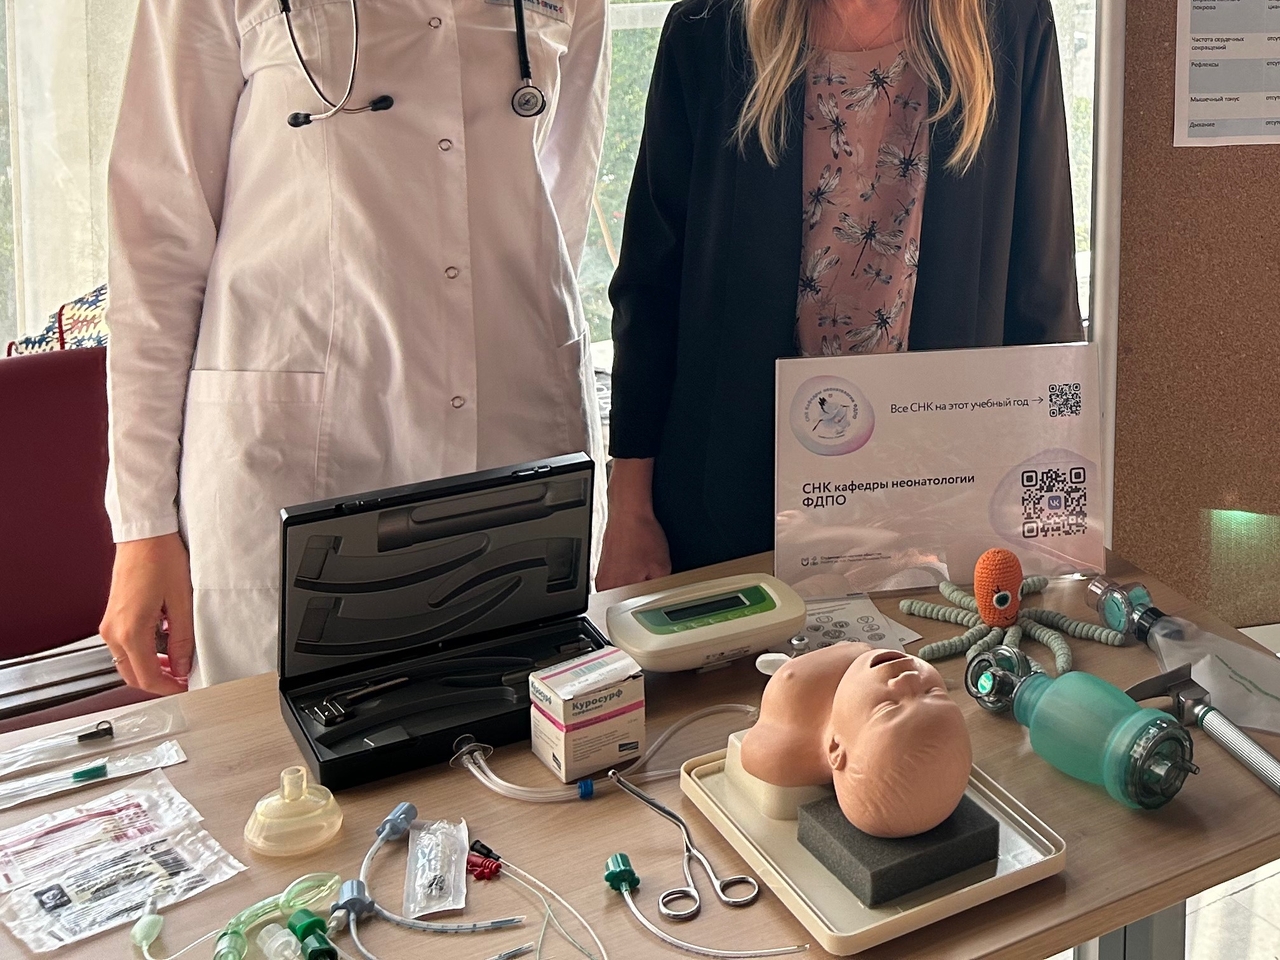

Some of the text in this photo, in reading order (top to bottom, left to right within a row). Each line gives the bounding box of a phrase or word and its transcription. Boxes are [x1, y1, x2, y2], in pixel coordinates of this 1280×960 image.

[890, 397, 1029, 414] Все СНК на этот учебный год
[802, 474, 975, 494] СНК кафедры неонатологии
[802, 494, 847, 508] ФДПО
[572, 688, 623, 711] Куросурф
